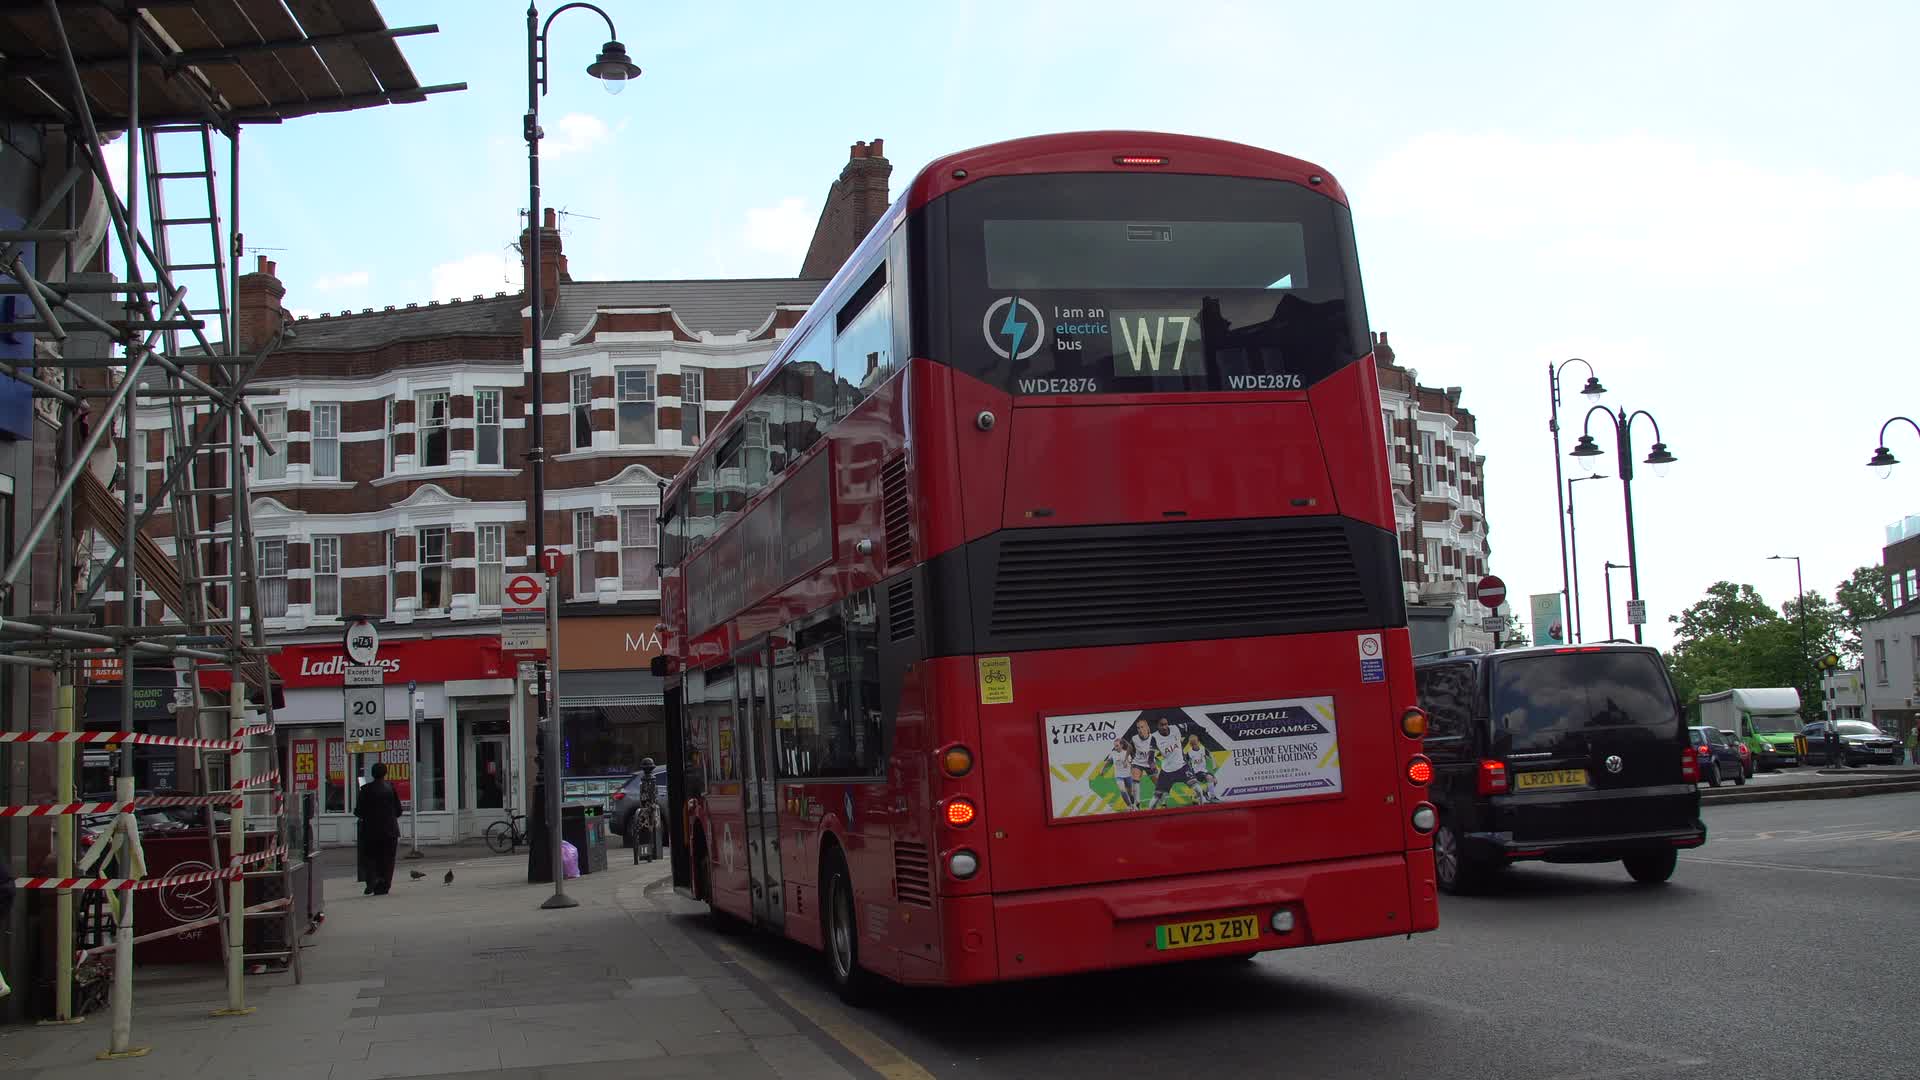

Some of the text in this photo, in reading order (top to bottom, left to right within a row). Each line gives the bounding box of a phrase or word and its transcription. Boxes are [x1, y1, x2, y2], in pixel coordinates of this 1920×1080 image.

[1054, 305, 1105, 319] I am an
[1055, 322, 1108, 335] electric
[1056, 338, 1083, 351] bus
[1119, 316, 1192, 371] W7
[1018, 377, 1098, 393] WDE2876
[1227, 374, 1302, 389] WDE2876
[545, 552, 559, 570] T
[625, 632, 663, 652] MA
[300, 655, 401, 677] Ladbkes
[347, 668, 370, 677] Except
[133, 689, 162, 699] RGANIC
[134, 699, 157, 709] FOOD
[352, 700, 377, 715] 20
[1222, 711, 1290, 724] FOOTBALL
[349, 727, 381, 739] ZONE
[1060, 720, 1117, 734] TRAIN
[1238, 722, 1319, 737] PROGRAMMES
[1063, 731, 1117, 744] LIKE A PRO
[381, 751, 409, 764] BIGGE
[1232, 742, 1319, 758] TERM-TIME EVENINGS
[296, 754, 315, 773] £5
[1234, 751, 1318, 767] & SCHOOL HOLIDAYS
[1168, 918, 1254, 945] LV23 ZBY
